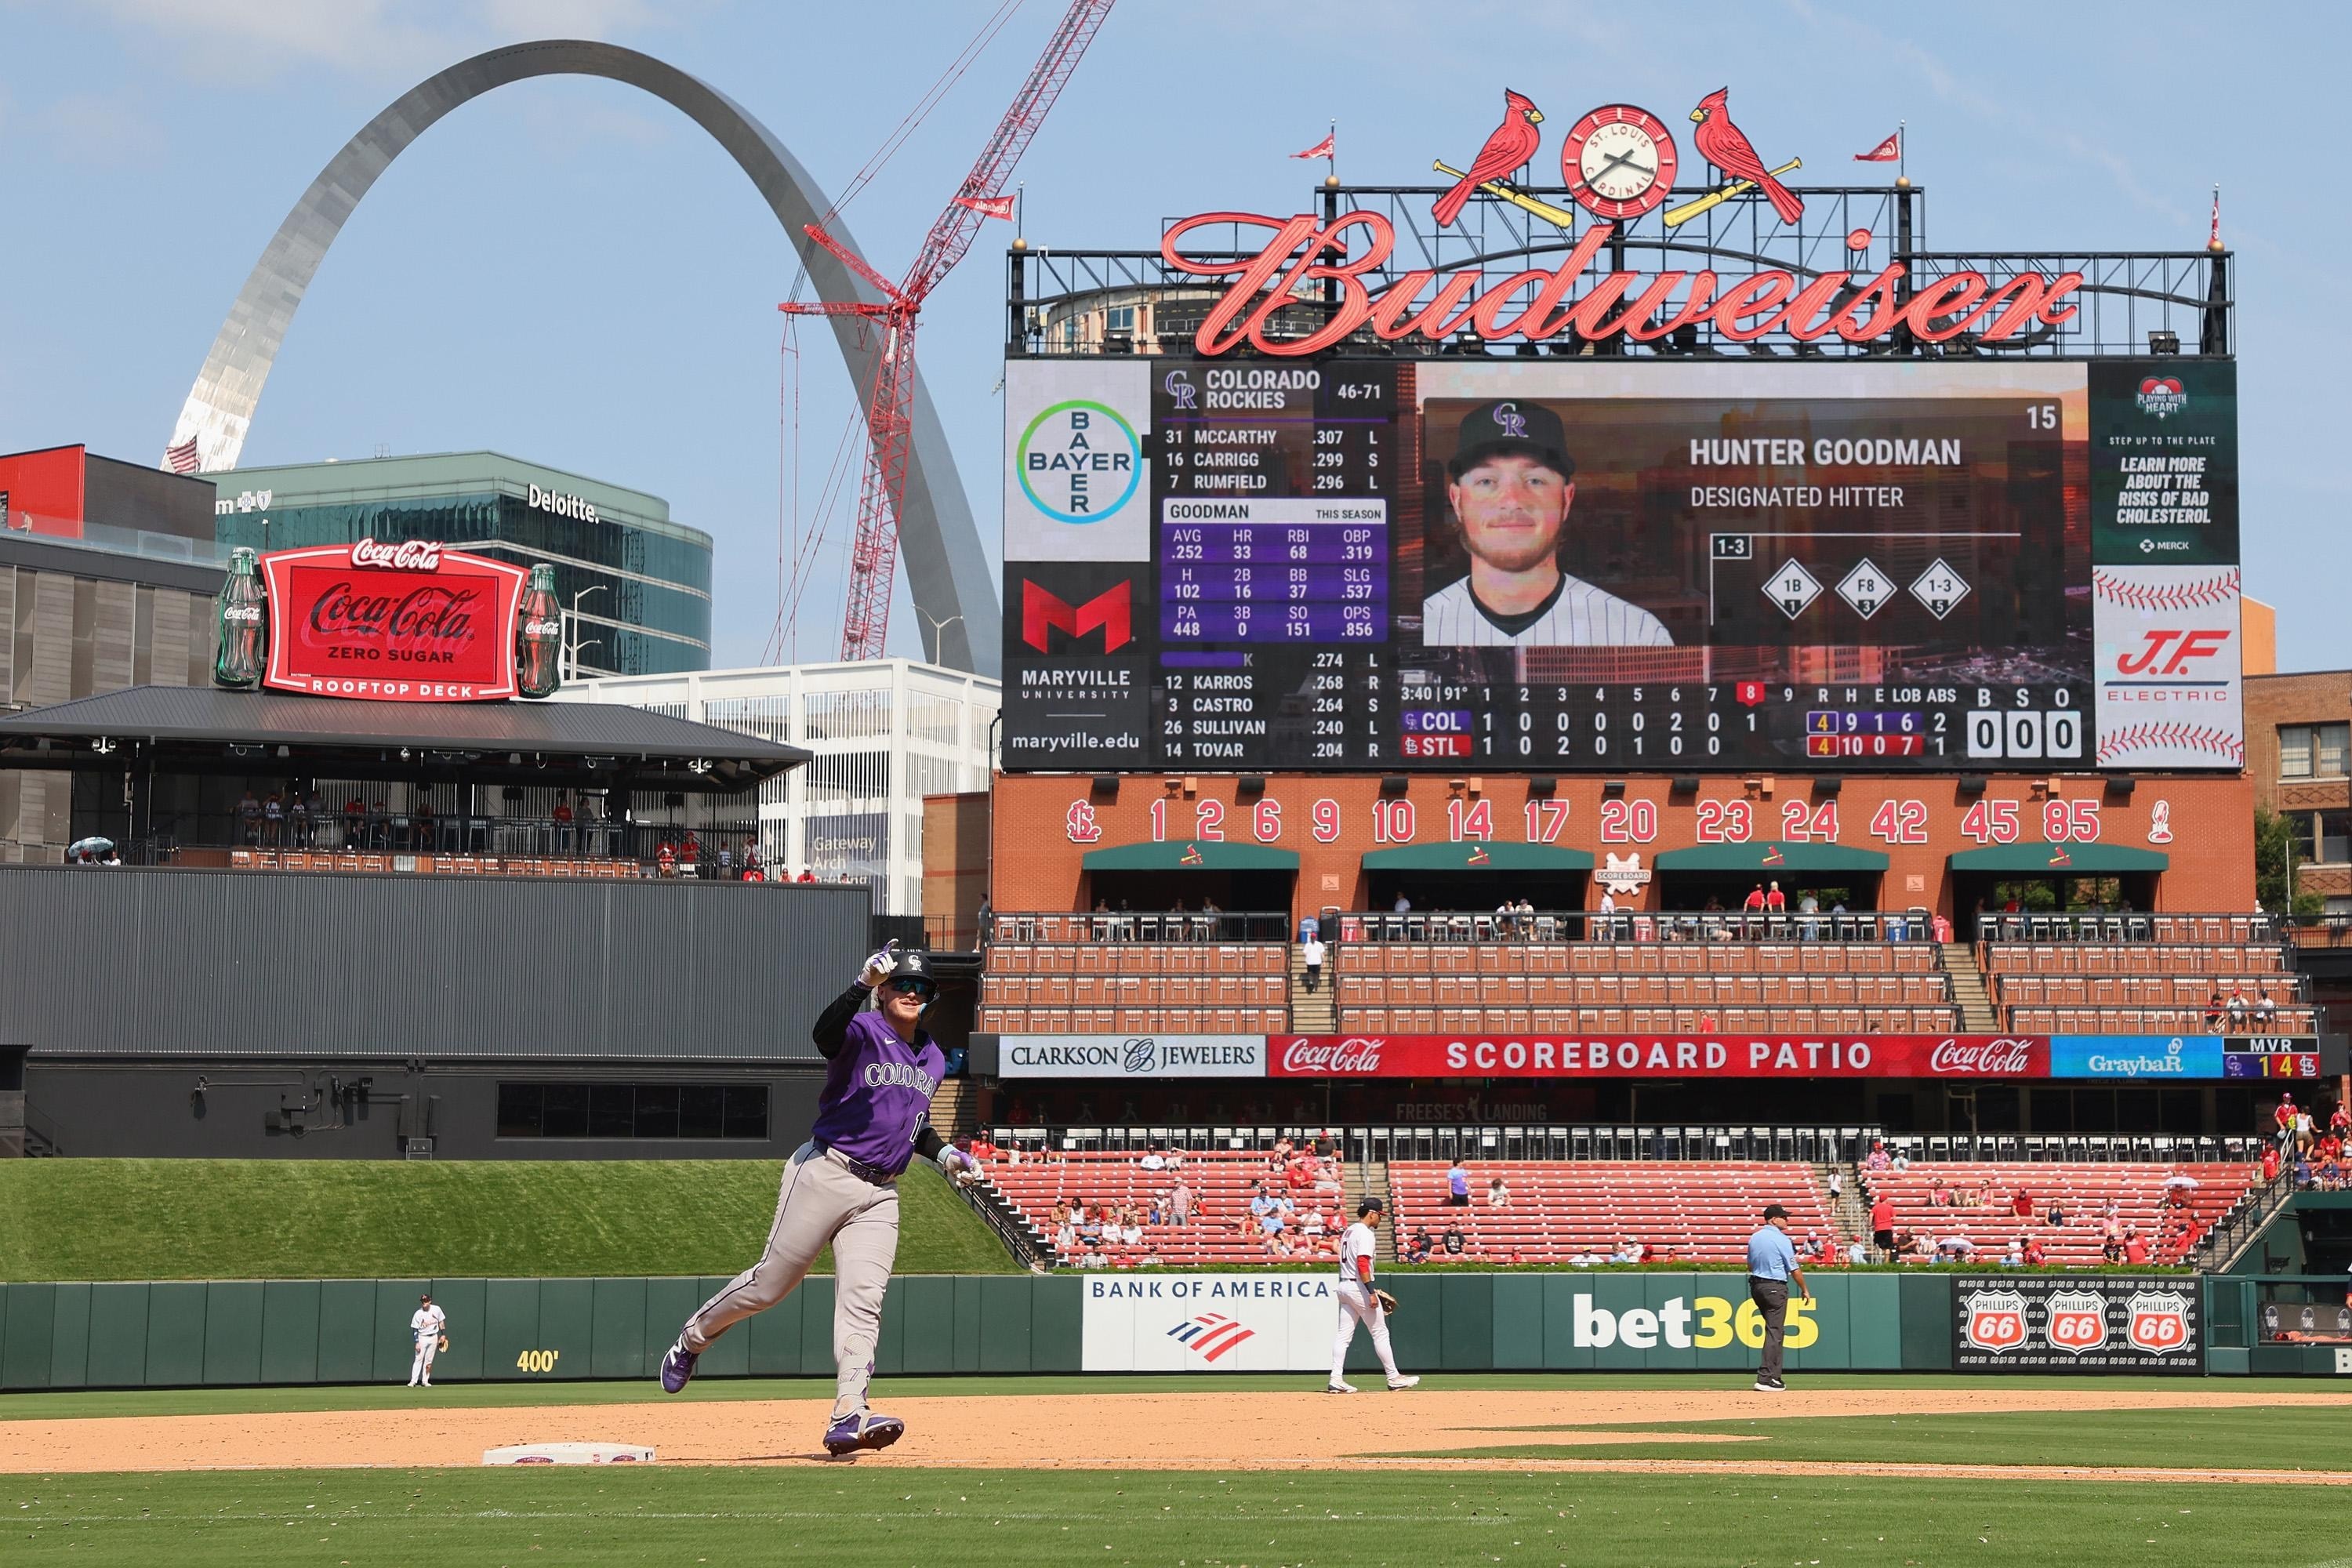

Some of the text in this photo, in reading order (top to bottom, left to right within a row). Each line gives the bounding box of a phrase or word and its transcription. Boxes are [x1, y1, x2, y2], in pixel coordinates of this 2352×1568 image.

[1611, 126, 1650, 147] LOUIS
[1160, 212, 2083, 356] Budweiser
[1207, 370, 1381, 399] COLORADO 46-71
[1207, 391, 1285, 408] ROCKIES
[2138, 394, 2187, 405] PLAYING WITH
[2146, 403, 2179, 412] HEART
[2026, 405, 2056, 430] 15
[1166, 430, 1344, 445] 31 MCCARTHY .307
[2110, 437, 2132, 445] STEP
[1166, 453, 1344, 467] 16 CARRIGG .299
[1690, 439, 1960, 466] HUNTER GOODMAN
[1029, 452, 1131, 470] BAYER
[1069, 412, 1091, 513] BAYER
[2121, 457, 2206, 472] LEARN MORE
[1170, 475, 1344, 489] 7 RUMFIELD .296
[2125, 474, 2201, 488] ABOUT THE
[1691, 487, 1904, 506] DESIGNATED HITTER
[2118, 492, 2209, 506] RISKS OF BAD
[1170, 504, 1381, 519] GOODMAN THIS SEASON
[2117, 508, 2211, 524] CHOLESTEROL
[1173, 529, 1371, 543] AVG HR RBI OBP
[1171, 546, 1373, 560] .252 33 68 .319
[1718, 539, 1745, 554] 1-3
[2158, 541, 2189, 550] MERCK
[352, 538, 443, 569] Coca-Cola
[1234, 568, 1370, 582] 2B BB SLG
[1174, 585, 1373, 599] 102 16 37 .537
[1784, 579, 1802, 592] 1B
[1857, 579, 1875, 592] F8
[1929, 579, 1951, 593] 1-3
[224, 607, 260, 620] Coca-Cola
[310, 582, 481, 638] Coca-Cola
[1178, 606, 1370, 619] PA 3B SO OPS
[525, 622, 559, 635] Coca-Cola
[1173, 622, 1373, 637] 448 151 .856
[328, 646, 454, 663] ZERO SUGAR
[1312, 654, 1343, 667] .274
[1022, 670, 1131, 686] MARYVILLE
[1165, 676, 1343, 690] 12 KARROS .268
[313, 680, 472, 697] ROOFTOP DECK
[1401, 687, 1468, 700] 3:40 91°
[1893, 688, 1956, 702] LOB ABS
[2107, 691, 2227, 701] ELECTRIC
[1169, 699, 1343, 713] 3 CASTRO .264
[1165, 720, 1343, 735] 26 SULLIVAN .240
[1422, 714, 1461, 731] COL
[1012, 732, 1139, 752] maryville.edu
[1423, 737, 1862, 756] STL 10
[1165, 743, 1343, 757] 14 TOVAR .204
[1151, 799, 2101, 844] 1 2 6 9 10 14 17 20 23 24 42 45 85
[814, 836, 877, 852] Gateway
[814, 855, 846, 869] Arch
[1597, 871, 1650, 880] SCOREBOARD
[2250, 1039, 2292, 1052] MVR
[1011, 1046, 1254, 1069] CLARKSON JEWELERS
[1283, 1038, 1386, 1073] Coca-Cola
[1446, 1042, 1871, 1069] SCOREBOARD PATIO
[1931, 1038, 2034, 1073] Coca-Cola
[2259, 1055, 2292, 1077] 1 4
[1396, 1103, 1547, 1120] FREESE'S LANDING
[1092, 1281, 1330, 1298] BANK OF AMERICA
[1976, 1301, 2019, 1311] PHILLIPS
[2055, 1301, 2098, 1311] PHILLIPS
[2136, 1301, 2180, 1312] PHILLIPS
[1573, 1294, 1820, 1349] bet365
[1978, 1316, 2016, 1339] 66
[2057, 1316, 2096, 1340] 66
[2138, 1317, 2177, 1341] 66
[517, 1350, 558, 1372] 400'
